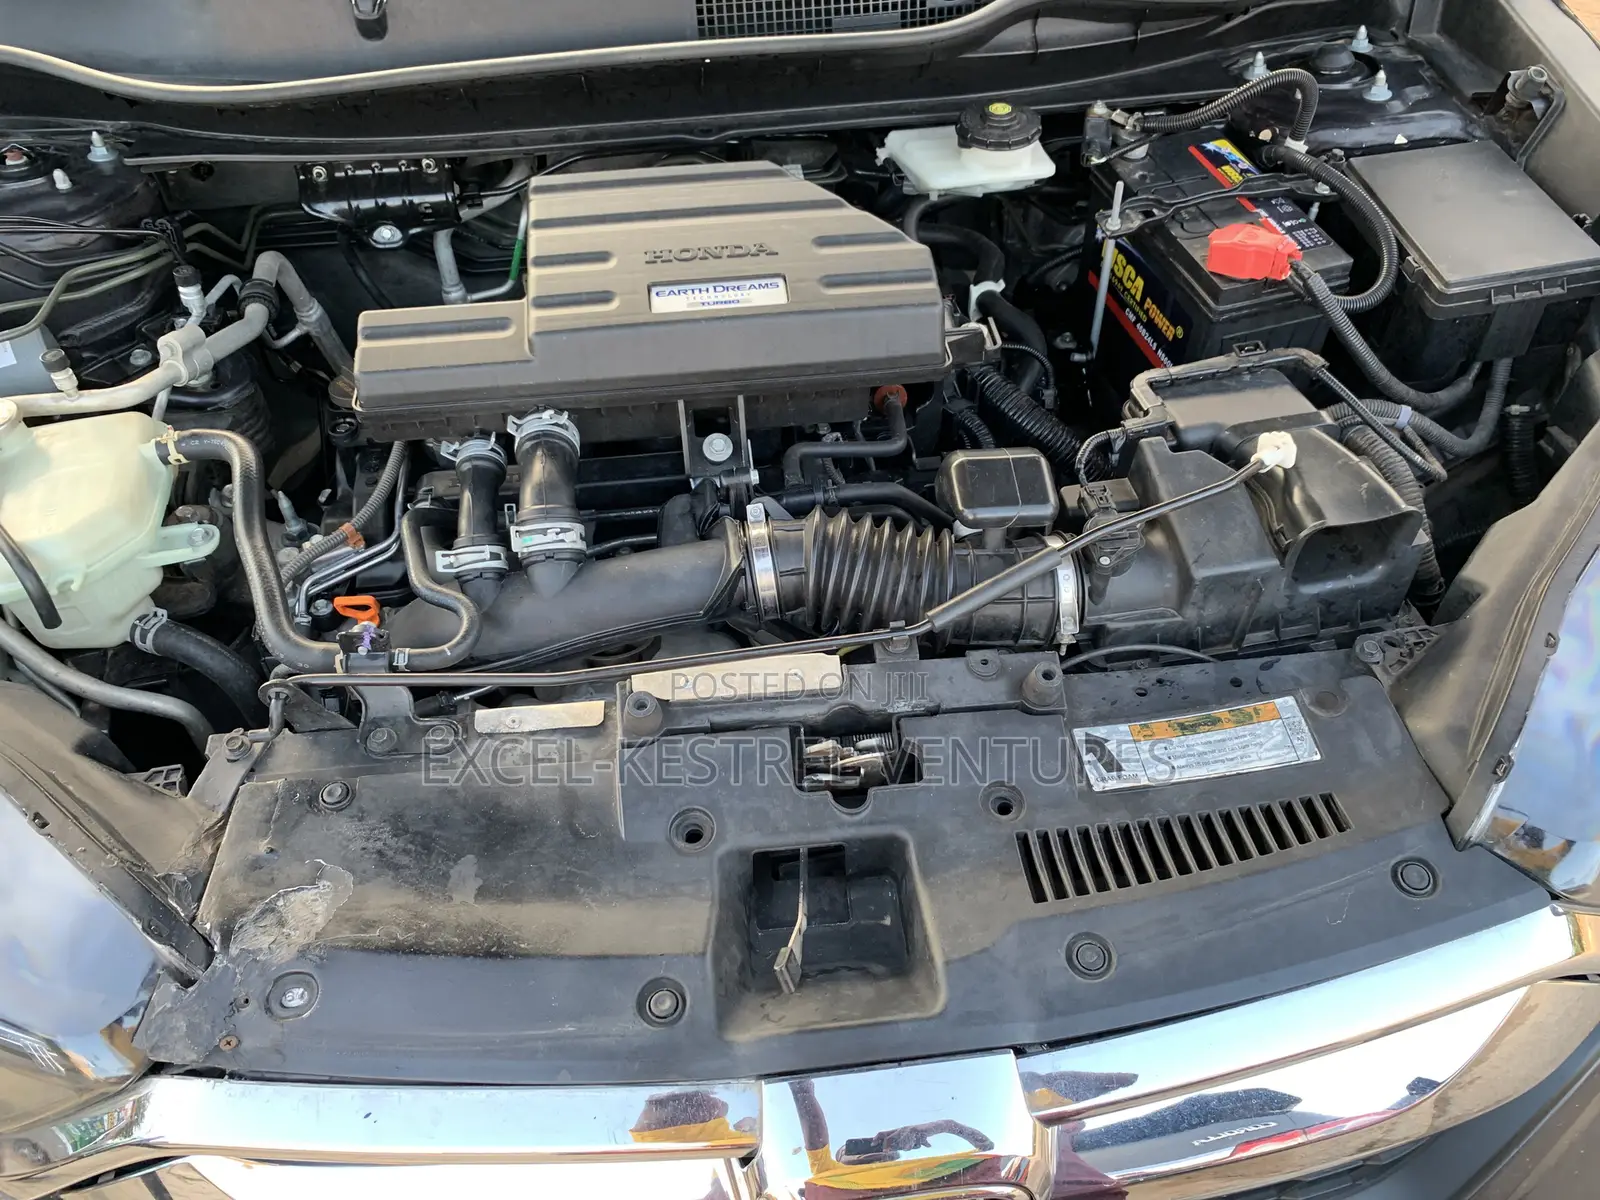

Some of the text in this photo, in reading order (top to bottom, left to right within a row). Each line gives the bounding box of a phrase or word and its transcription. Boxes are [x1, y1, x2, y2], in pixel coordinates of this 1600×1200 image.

[644, 243, 779, 264] HONDA
[656, 281, 780, 298] EARTH DREAMS
[700, 299, 741, 307] TURBO
